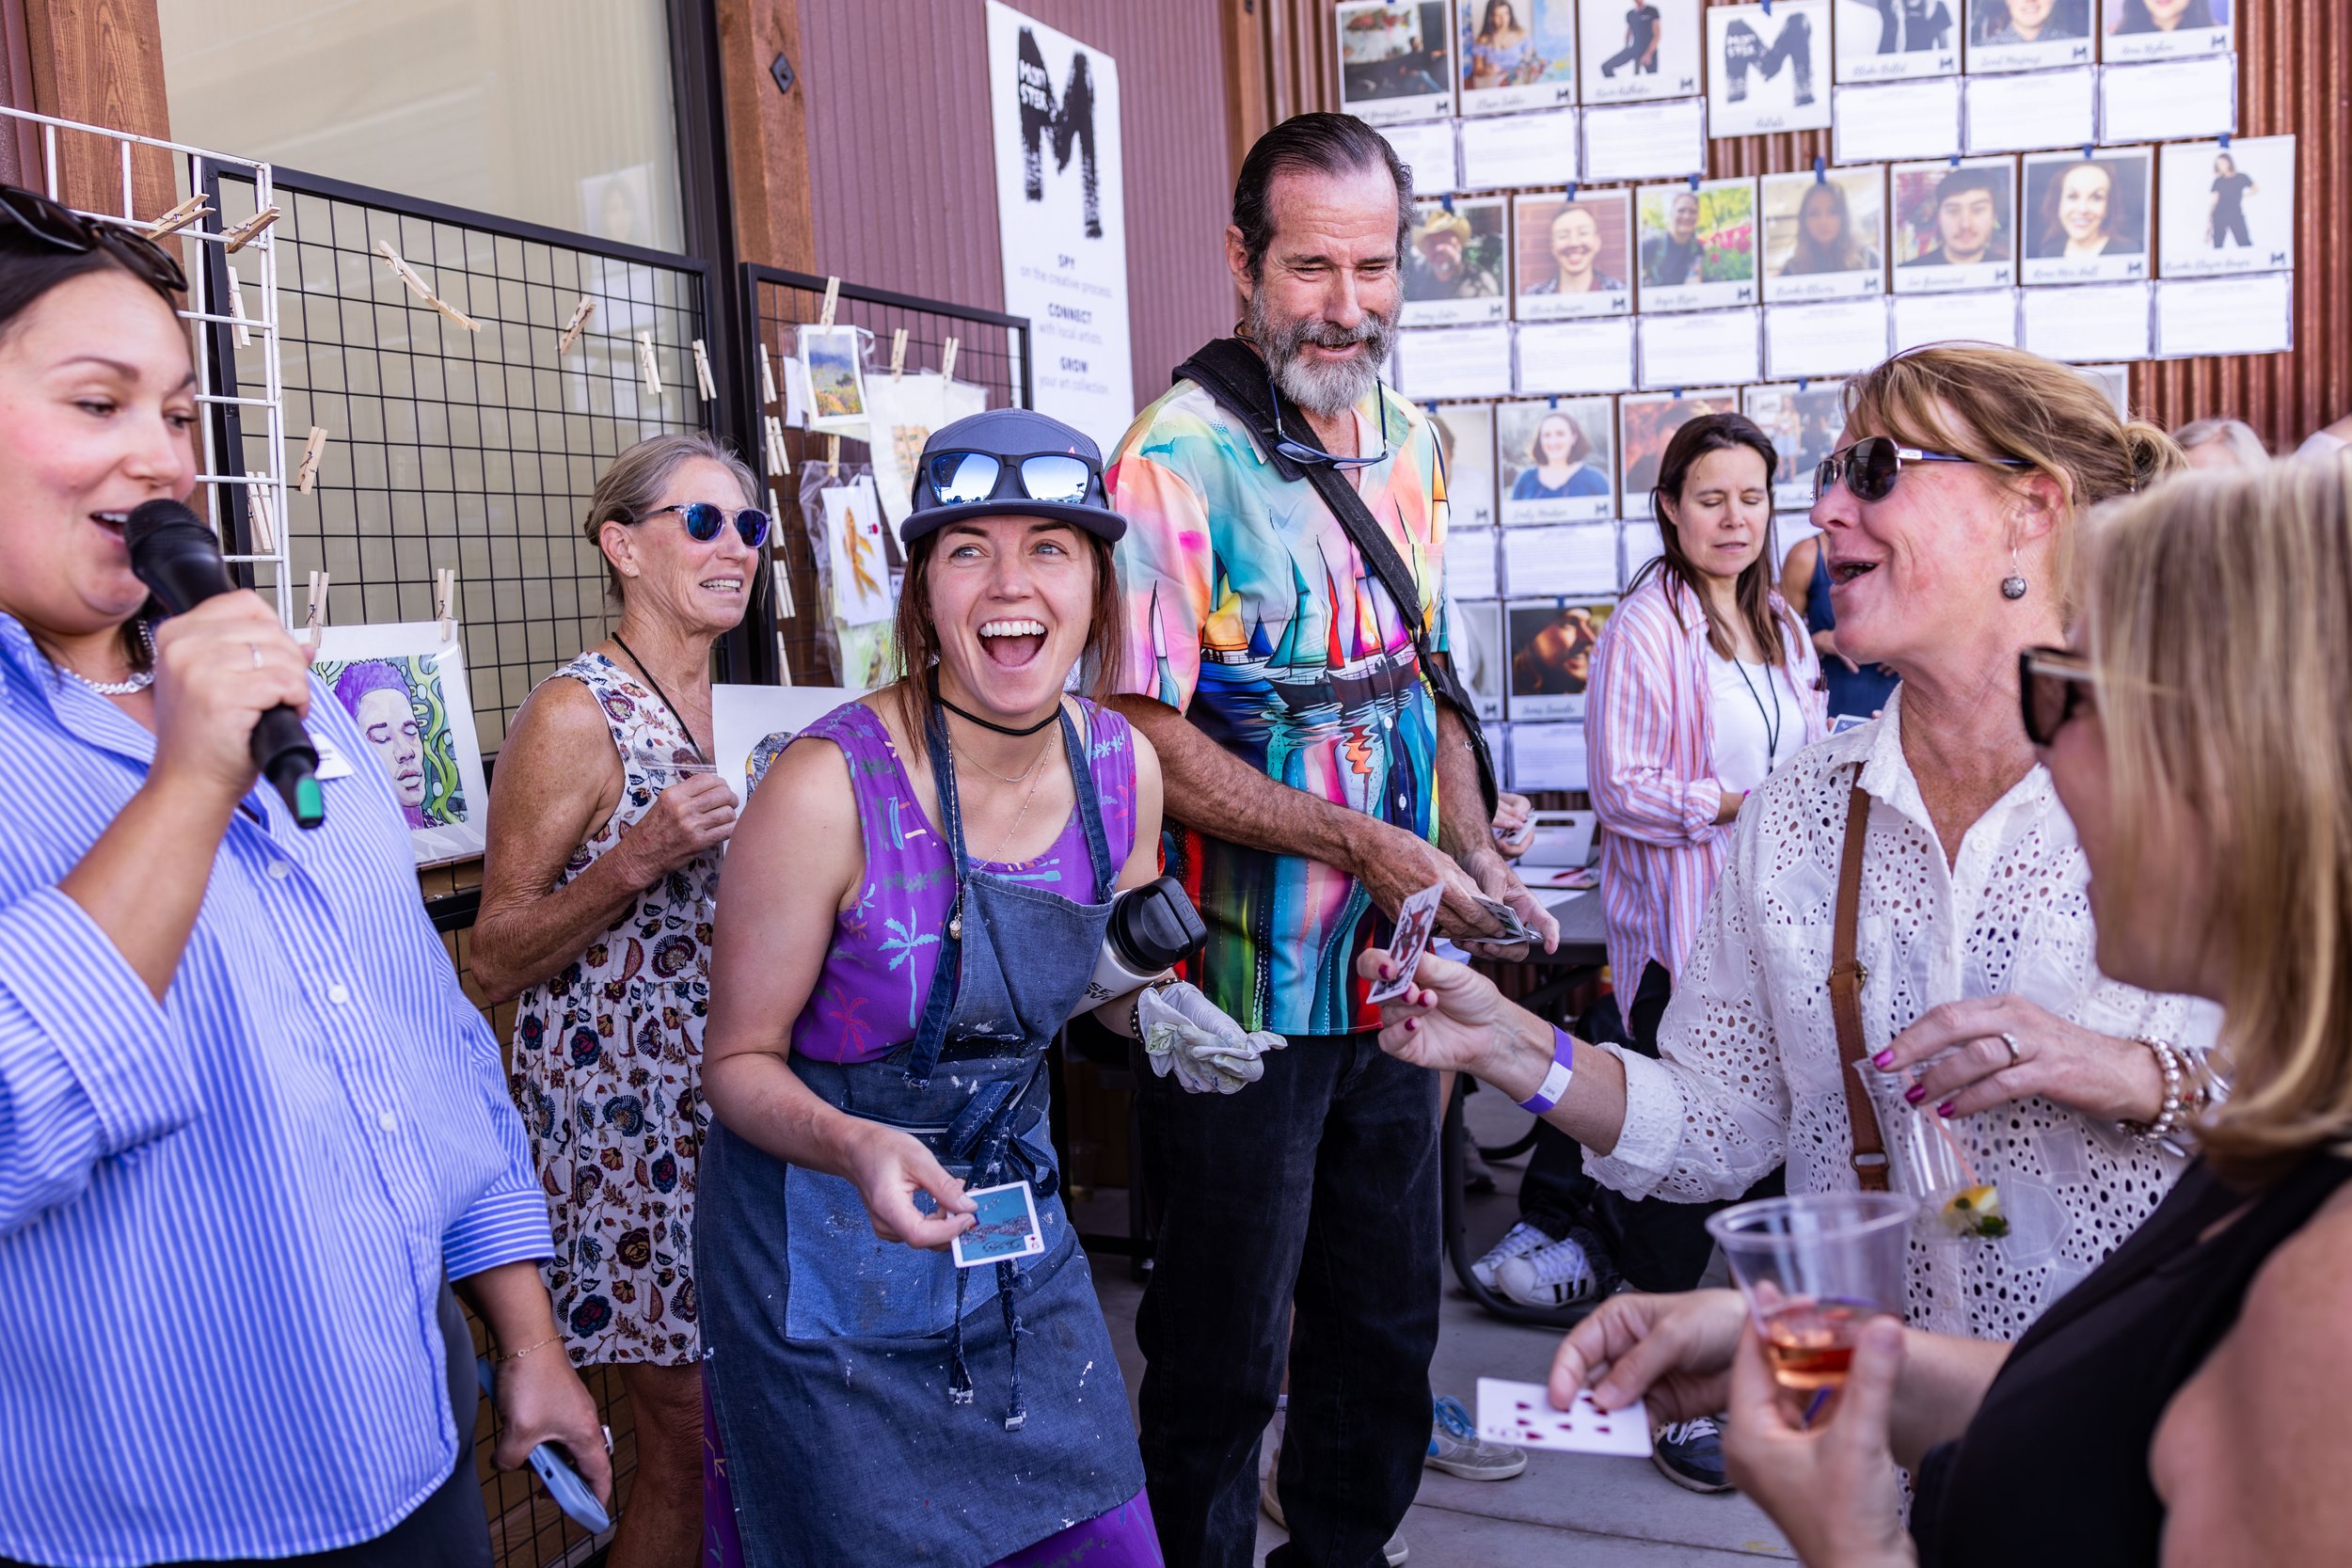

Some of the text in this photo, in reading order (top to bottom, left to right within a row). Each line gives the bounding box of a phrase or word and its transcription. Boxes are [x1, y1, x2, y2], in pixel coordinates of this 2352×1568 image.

[1057, 253, 1076, 271] SPY
[1047, 302, 1092, 325] CONNECT
[1059, 356, 1089, 374] GROW
[1173, 886, 1204, 933] YETI
[1088, 982, 1115, 995] SE
